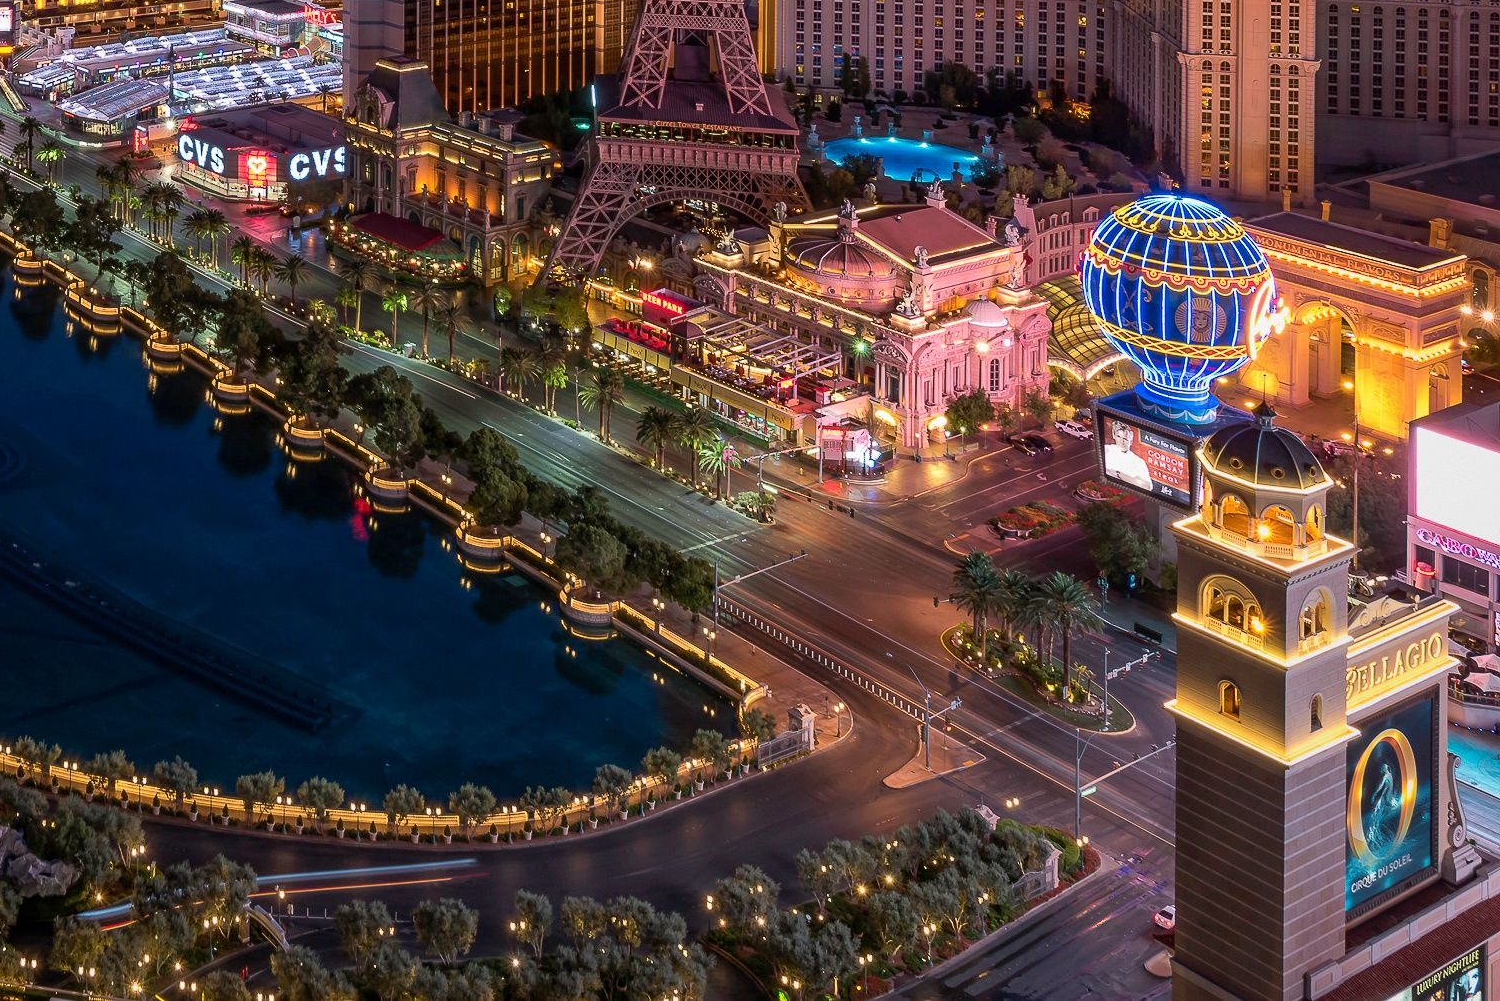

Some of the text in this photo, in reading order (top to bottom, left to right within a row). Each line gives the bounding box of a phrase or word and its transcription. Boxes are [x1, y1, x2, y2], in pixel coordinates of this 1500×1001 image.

[178, 134, 225, 174] CVS
[1255, 235, 1401, 281] MONUMENTAL FLAVORS
[642, 292, 682, 314] BEER PARK
[1147, 449, 1184, 468] GORDON
[1147, 456, 1184, 476] RAMSAY
[1416, 528, 1477, 559] CABO
[1351, 853, 1413, 893] CIRQUE DU SOLEIL
[1416, 971, 1442, 996] LUXURY
[1442, 949, 1480, 979] NIGHTLIFE
